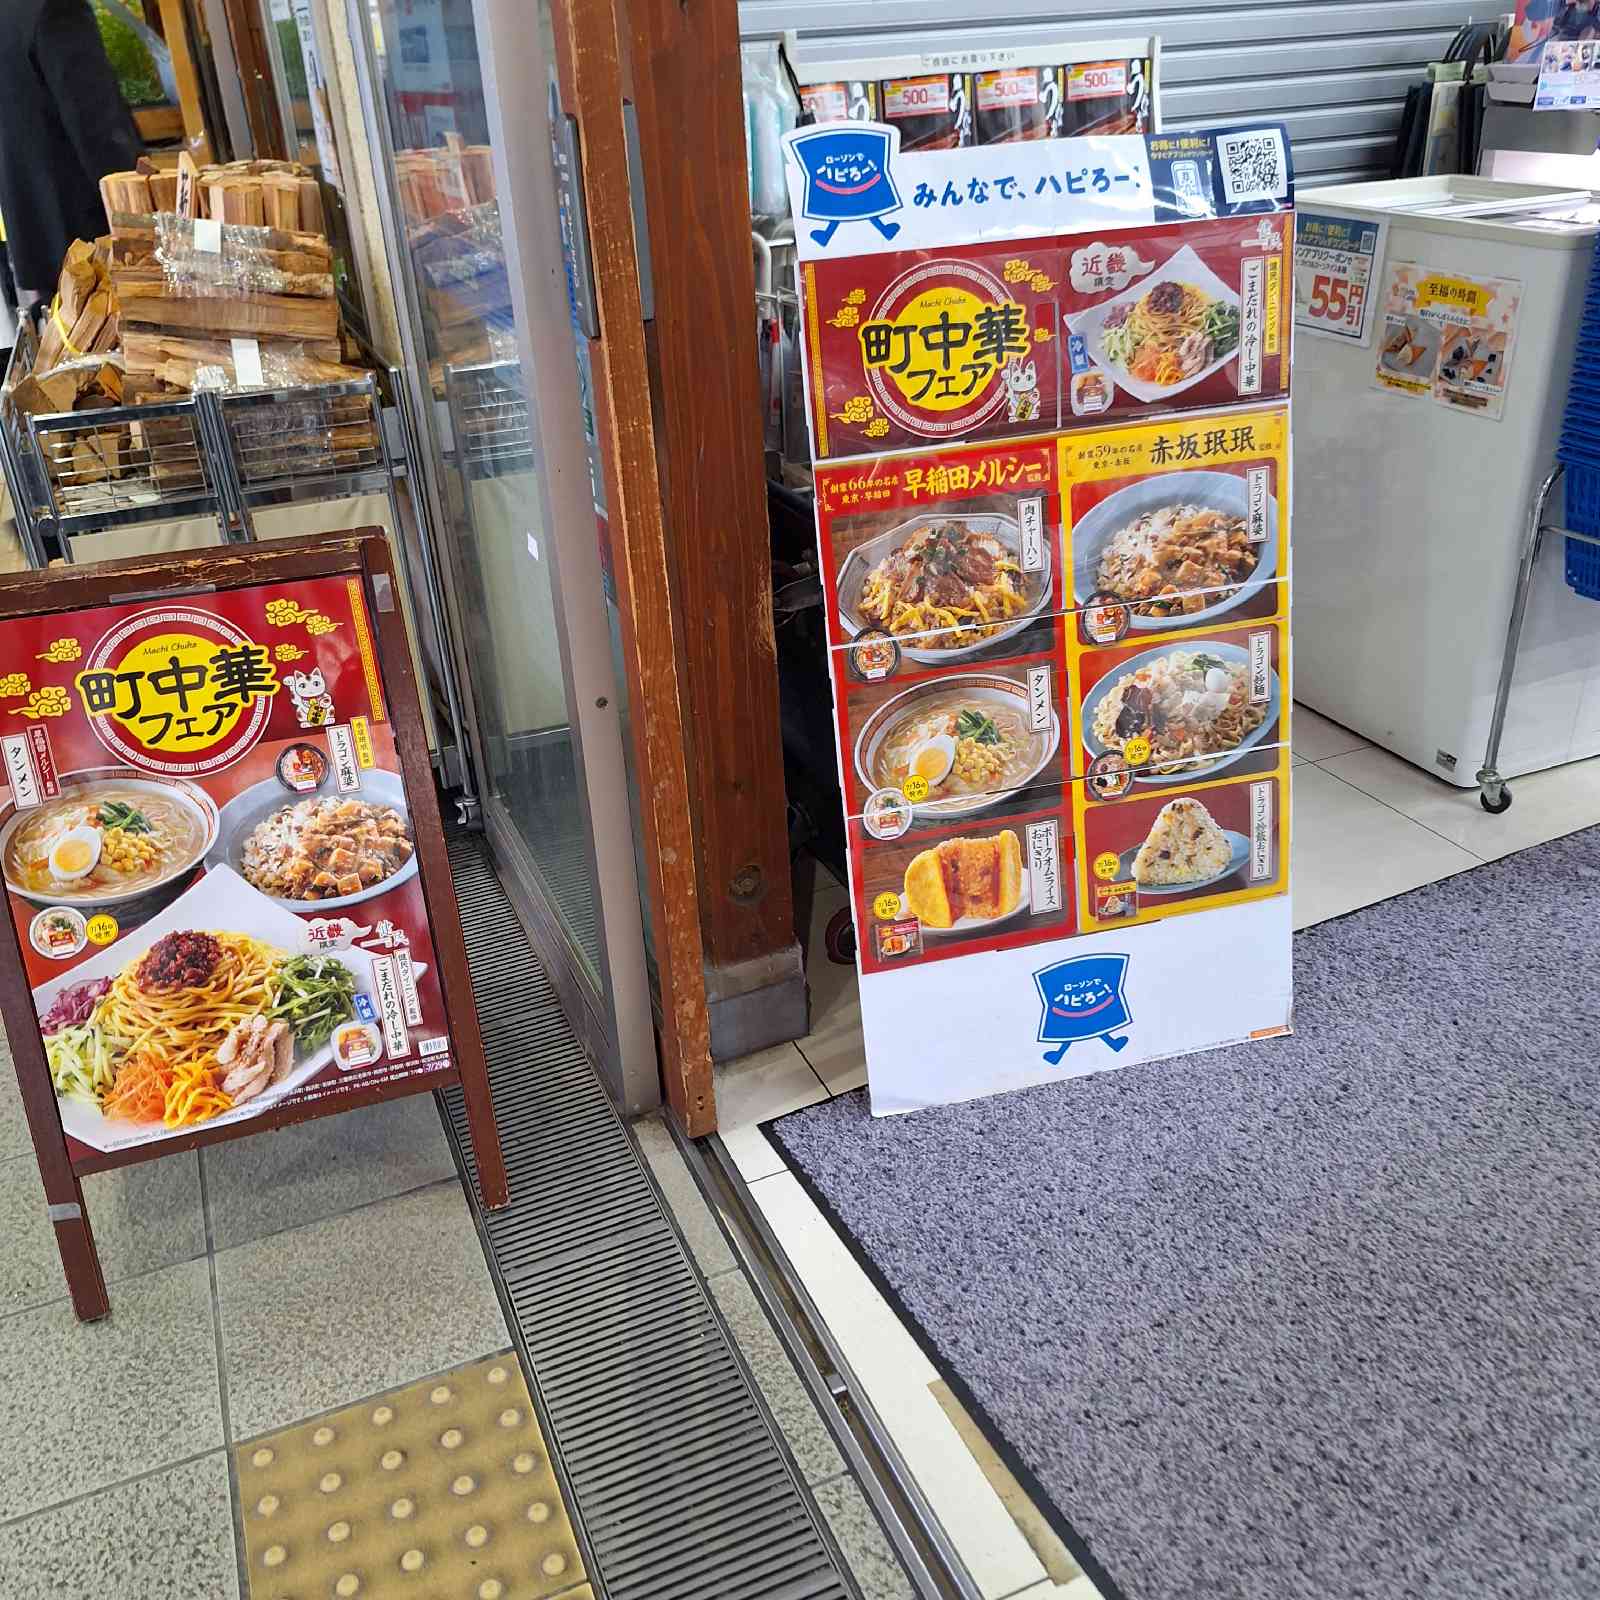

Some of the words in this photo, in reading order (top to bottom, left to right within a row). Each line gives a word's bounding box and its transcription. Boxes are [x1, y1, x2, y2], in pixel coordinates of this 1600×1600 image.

[903, 88, 928, 106] 500
[995, 82, 1018, 97] 500
[1084, 72, 1108, 89] 500
[826, 153, 864, 164] ローソンで
[1082, 252, 1127, 276] 近畿
[862, 303, 1027, 374] 町中華
[907, 362, 992, 401] フェア
[1149, 425, 1256, 464] 赤坂珉珉
[902, 456, 1042, 499] 早稲田メルシー
[1024, 504, 1038, 566] 肉チャーハン
[144, 647, 169, 657] Machi
[80, 646, 277, 719] 町中華
[1034, 674, 1047, 724] タンメン
[138, 702, 238, 745] フェア
[11, 747, 32, 797] タンメン
[336, 730, 354, 787] ドラゴン麻婆
[308, 923, 344, 942] 近畿
[1054, 984, 1113, 1007] ハピろー!
[1064, 978, 1101, 991] ローソンで
[379, 961, 402, 1051] ごまだれの冷し中華
